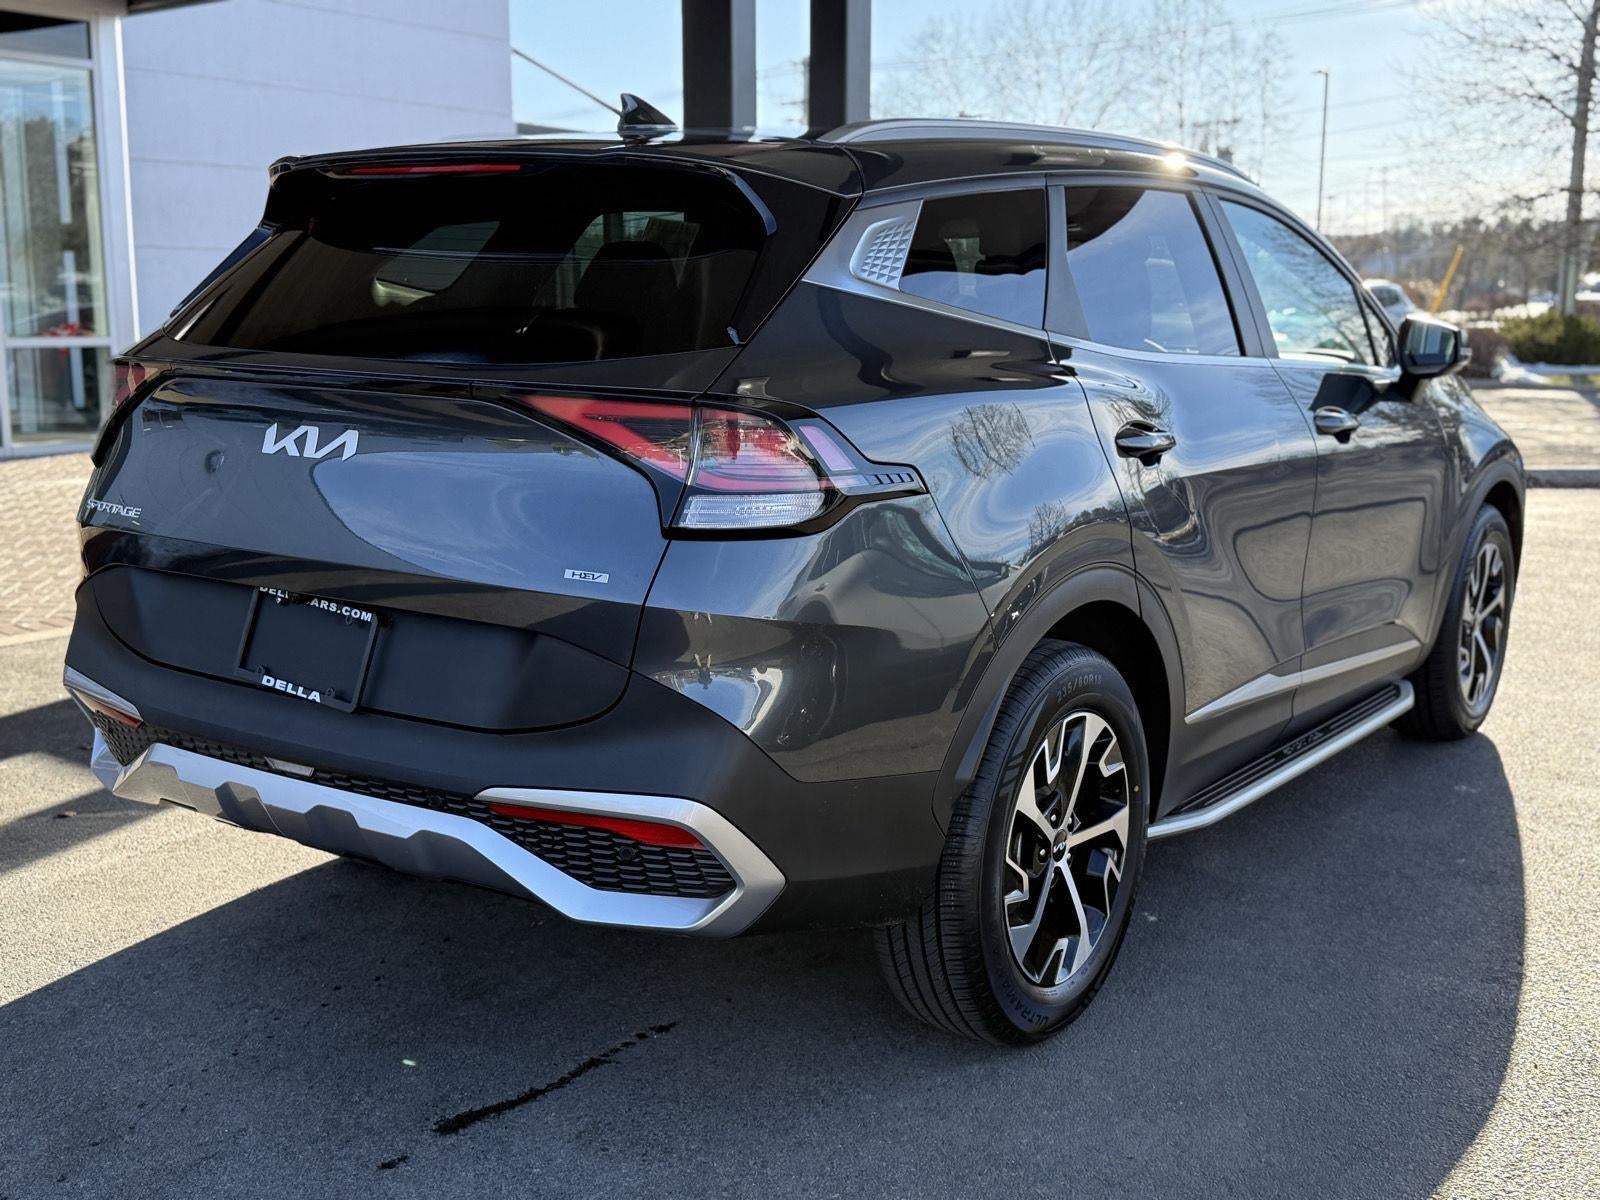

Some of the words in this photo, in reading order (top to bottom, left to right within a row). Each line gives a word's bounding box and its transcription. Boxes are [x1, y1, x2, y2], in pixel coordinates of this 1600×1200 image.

[262, 422, 359, 462] KIA
[87, 499, 142, 518] SPORTAGE
[570, 570, 604, 581] HEV
[259, 587, 372, 622] DELARS.COM
[261, 674, 322, 704] DELLA
